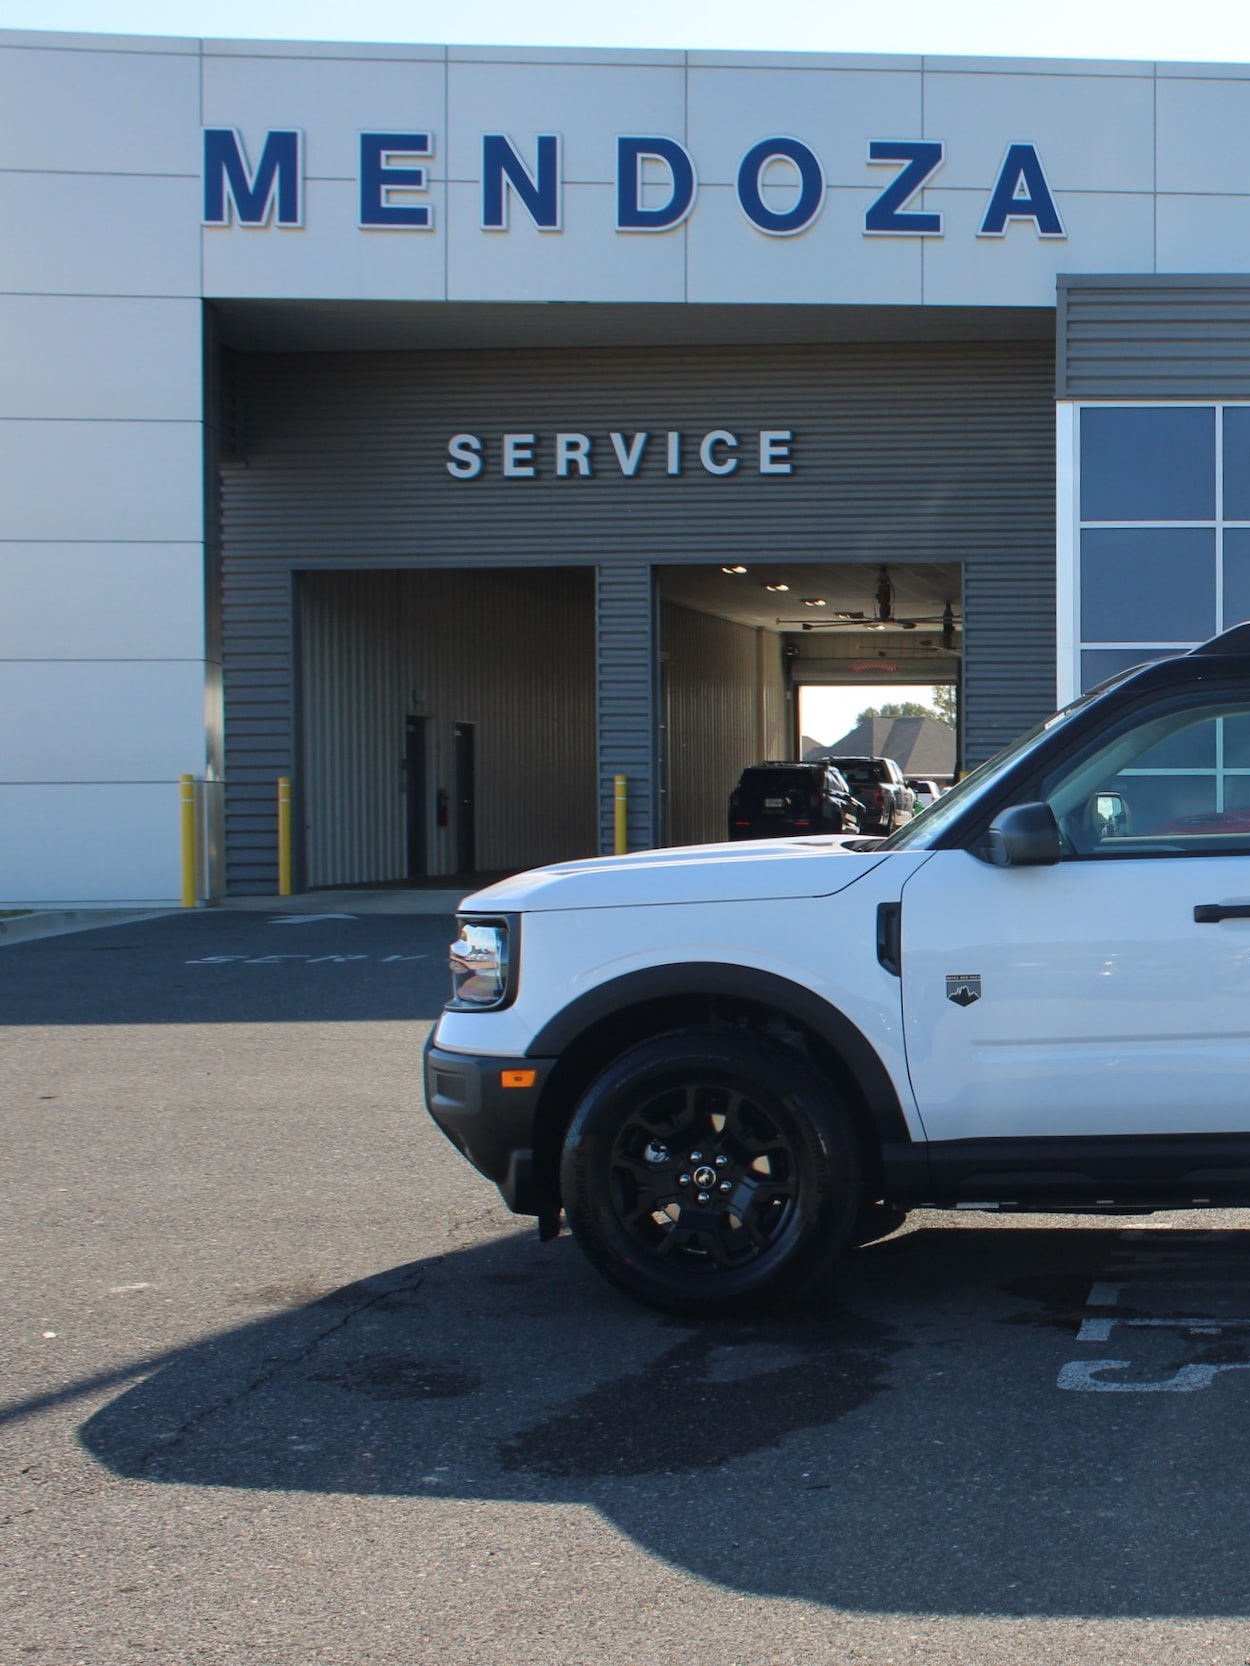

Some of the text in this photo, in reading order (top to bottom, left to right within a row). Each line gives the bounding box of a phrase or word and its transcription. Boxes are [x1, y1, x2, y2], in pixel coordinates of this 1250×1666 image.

[200, 126, 1069, 240] MENDOZA
[445, 430, 796, 480] SERVICE
[184, 954, 430, 965] SERV
